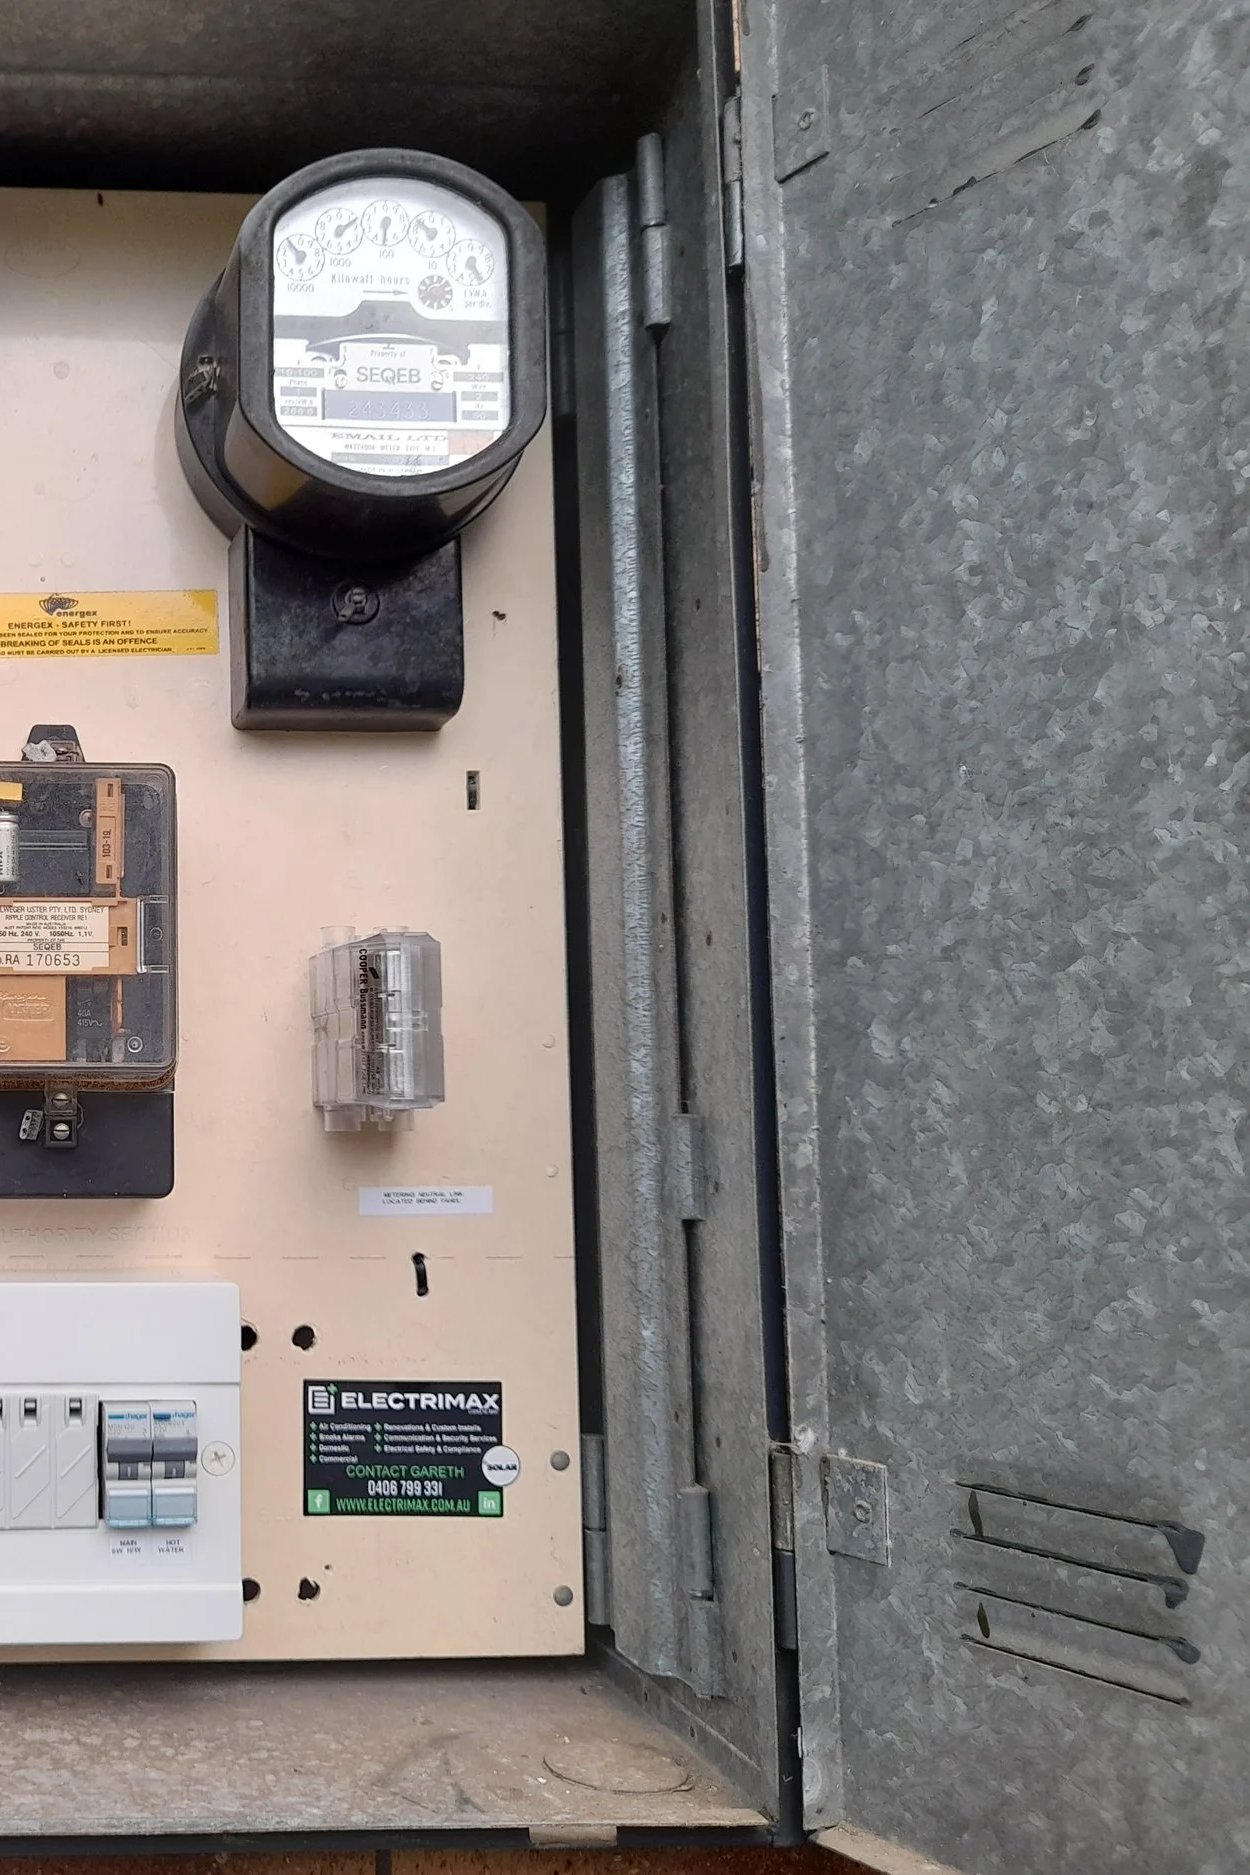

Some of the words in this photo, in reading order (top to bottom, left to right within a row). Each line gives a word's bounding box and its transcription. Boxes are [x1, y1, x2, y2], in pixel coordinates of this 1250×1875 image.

[378, 249, 395, 259] 100
[329, 259, 352, 268] 1000
[427, 260, 438, 270] 10
[330, 273, 374, 284] Kilowatt
[380, 274, 410, 285] hours
[287, 283, 315, 293] 10000
[355, 366, 422, 385] SEQEB
[331, 432, 400, 441] EMAIL
[407, 434, 447, 442] LTD
[57, 610, 99, 619] energex
[7, 621, 54, 630] ENERGEX
[61, 620, 98, 630] SAFETY
[0, 640, 47, 648] BREAKING
[47, 639, 60, 647] OF
[62, 639, 91, 647] SEALS
[92, 638, 101, 646] IS
[102, 638, 116, 646] AN
[116, 637, 159, 646] OFFENCE
[27, 906, 47, 914] USTER
[79, 906, 105, 914] SYDNEY
[32, 943, 63, 951] SEQEB
[26, 953, 82, 967] 170653
[358, 948, 369, 985] COOPER
[359, 988, 369, 1030] Bussmann
[340, 1391, 500, 1411] ELECTRIMAX
[126, 1411, 148, 1420] hager
[173, 1409, 195, 1419] hager
[329, 1423, 372, 1432] Conditioning
[383, 1423, 424, 1431] Renovations
[425, 1423, 431, 1431] &
[431, 1423, 457, 1431] Custom
[458, 1424, 482, 1432] Installs
[342, 1434, 366, 1443] Alarms
[383, 1433, 435, 1442] Communication
[435, 1434, 441, 1442] &
[442, 1434, 469, 1443] Security
[470, 1435, 498, 1443] Services
[318, 1444, 350, 1453] Domestic
[383, 1444, 414, 1453] Electrical
[415, 1445, 437, 1454] Safety
[443, 1445, 482, 1454] Compliance
[318, 1455, 358, 1464] Commercial
[345, 1465, 408, 1479] CONTACT
[410, 1465, 465, 1479] GARETH
[486, 1463, 518, 1472] SOLAR
[367, 1480, 400, 1497] 0406
[400, 1480, 423, 1497] 799
[423, 1480, 443, 1497] 331
[336, 1498, 471, 1513] WWW.ELECTRIMAX.COM.AU
